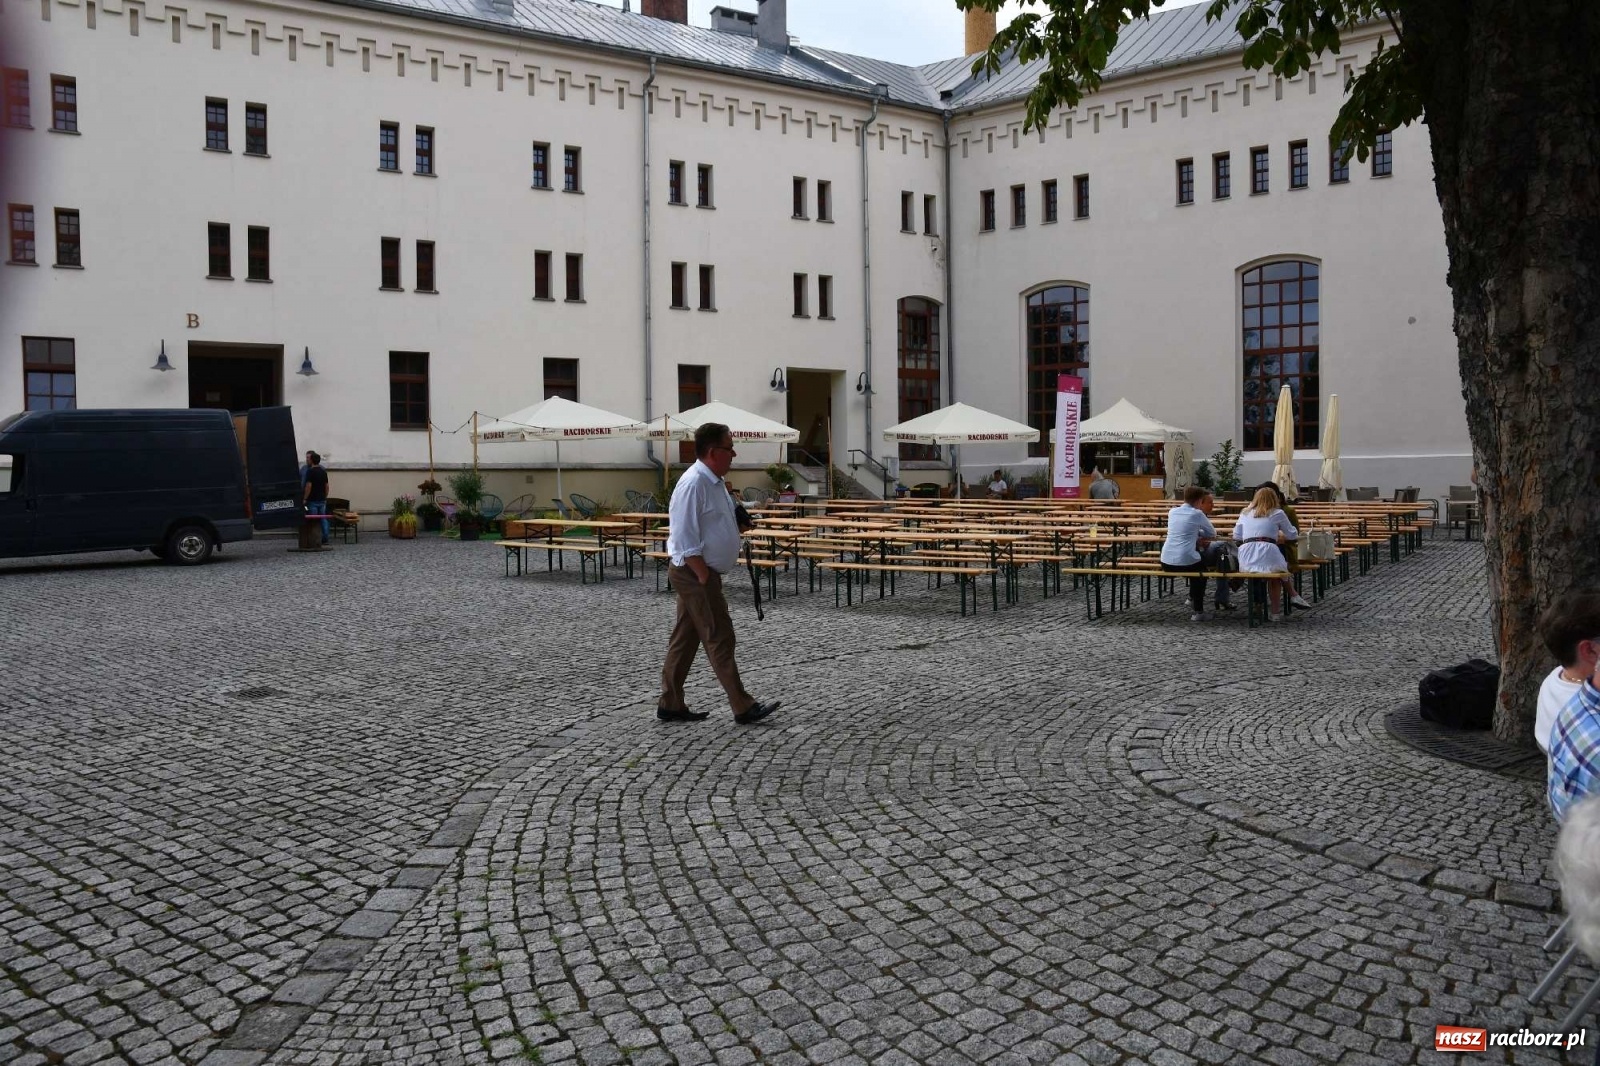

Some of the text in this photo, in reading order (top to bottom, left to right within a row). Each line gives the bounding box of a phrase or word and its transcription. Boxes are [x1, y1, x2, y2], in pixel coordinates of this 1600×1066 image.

[186, 313, 199, 328] B
[563, 427, 612, 436] RACIBORSKIE
[967, 433, 1009, 441] RACIBORSKIE
[1064, 400, 1078, 479] RACIBORSKIE
